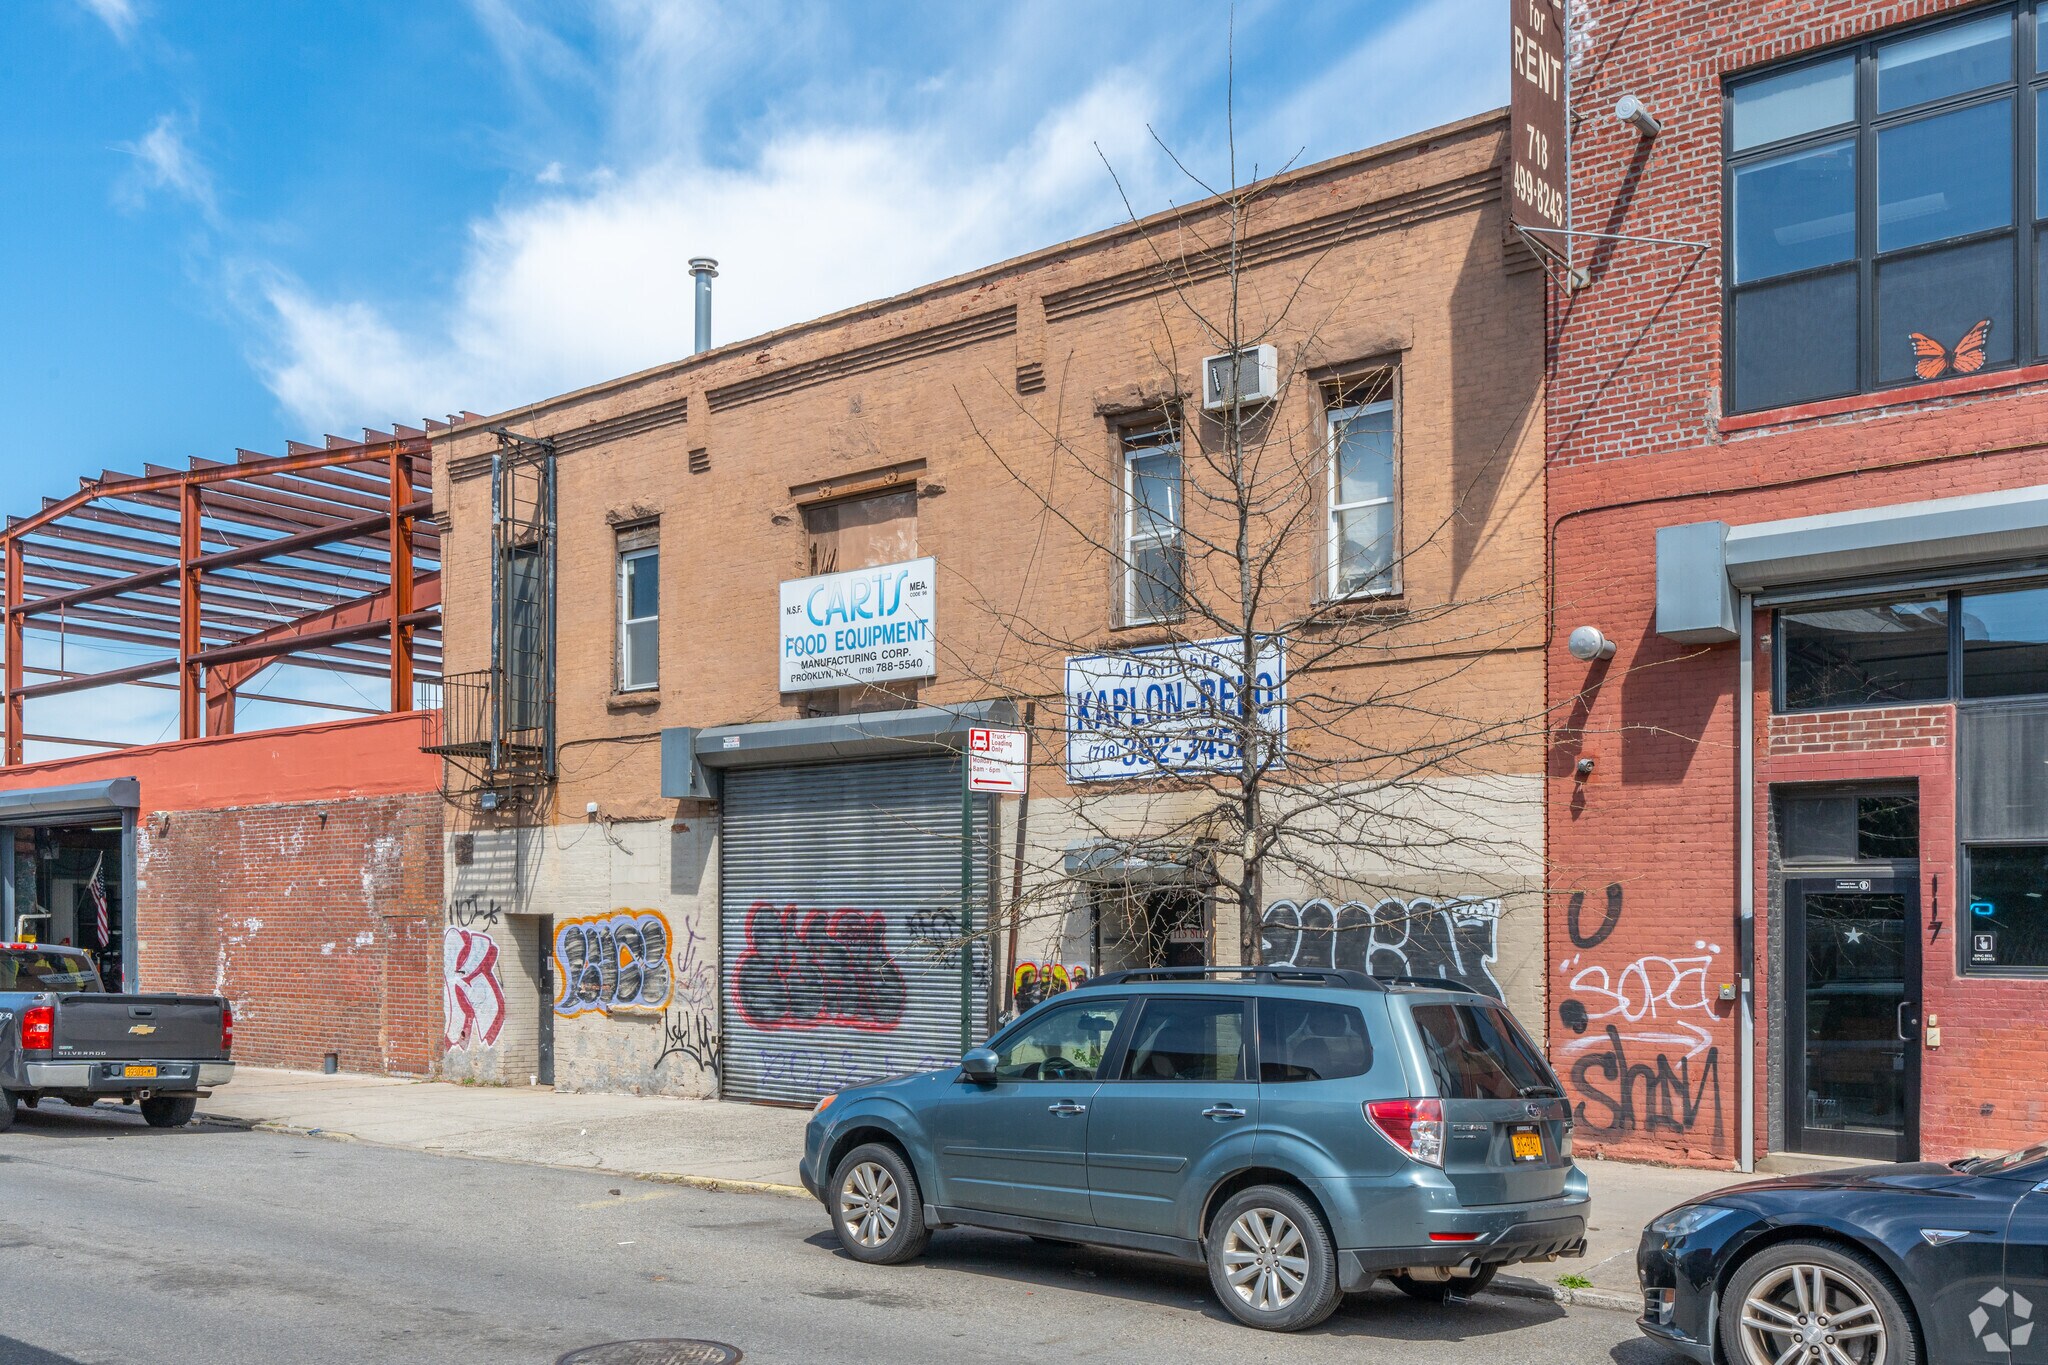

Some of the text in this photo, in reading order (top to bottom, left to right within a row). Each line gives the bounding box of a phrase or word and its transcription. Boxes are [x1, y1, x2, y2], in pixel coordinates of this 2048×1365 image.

[1529, 0, 1546, 35] for
[1514, 25, 1562, 102] RENT
[1526, 123, 1548, 171] 718
[1513, 161, 1563, 227] 499-8243
[806, 569, 909, 627] CARTS
[909, 581, 928, 592] MEA.
[786, 605, 803, 615] N.S.F.
[785, 618, 929, 658] FOOD EQUIPMENT
[800, 648, 912, 669] MANUFACTURING CORP.
[858, 666, 875, 675] (718)
[876, 658, 923, 673] 788-5540
[991, 740, 1012, 748] Loading
[1088, 745, 1120, 762] (718)
